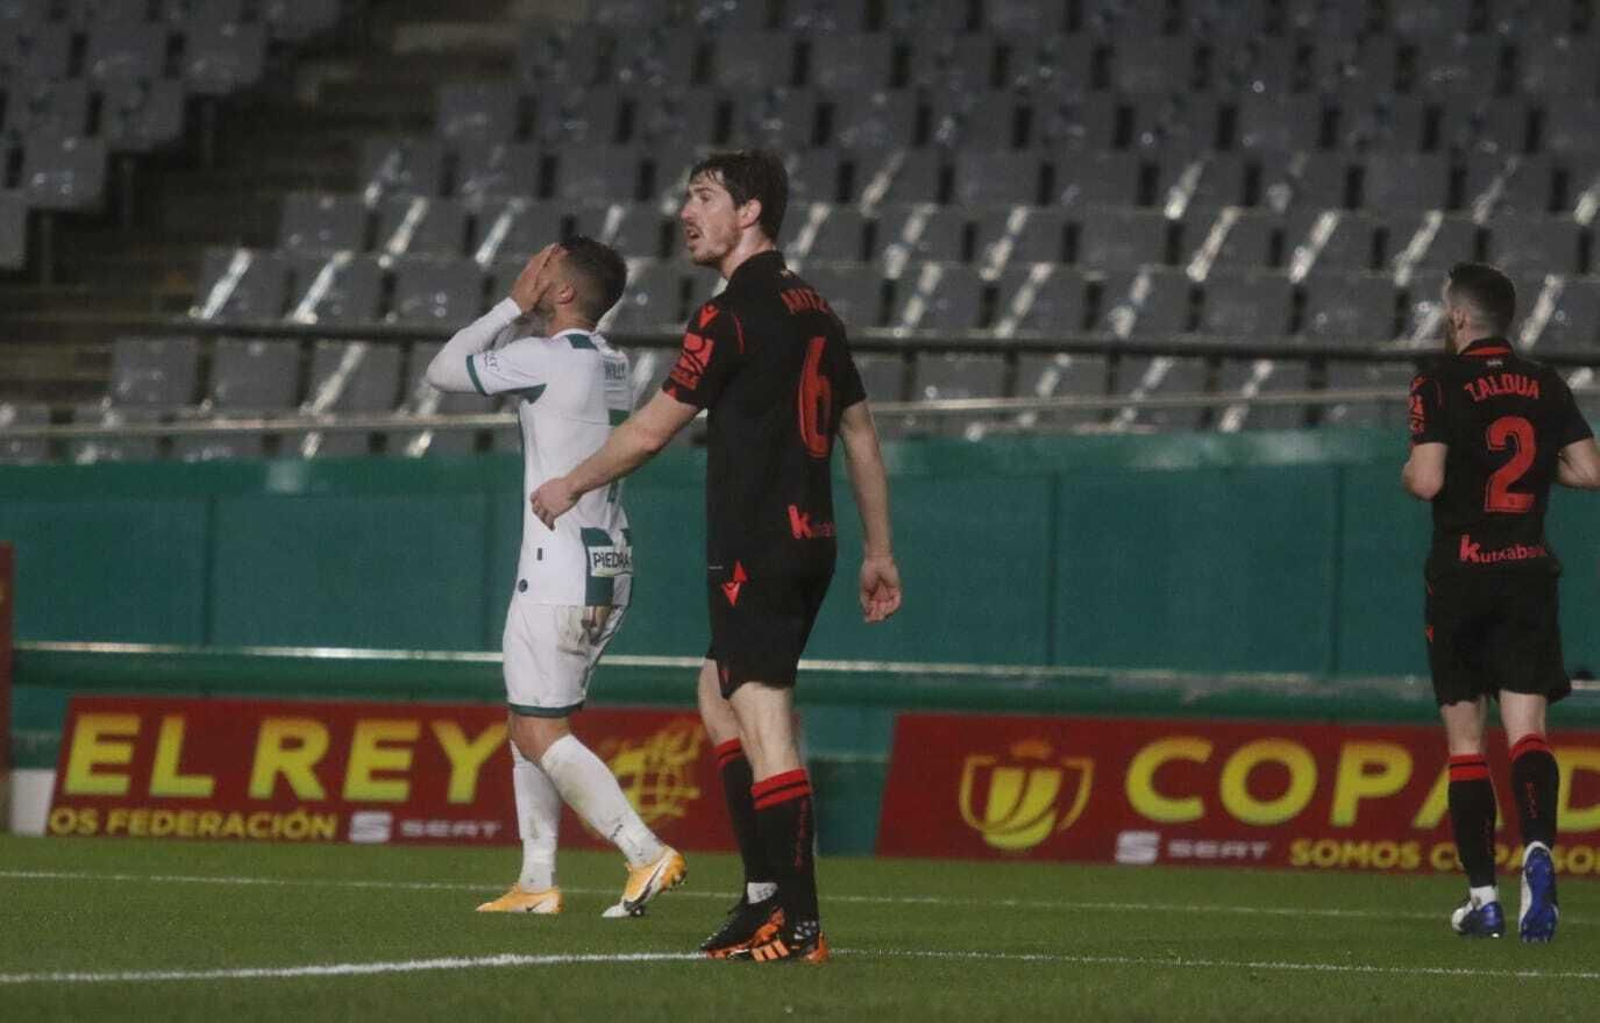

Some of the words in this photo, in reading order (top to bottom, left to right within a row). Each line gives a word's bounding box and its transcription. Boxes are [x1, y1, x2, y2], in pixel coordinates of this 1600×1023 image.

[799, 336, 833, 459] 6
[1463, 373, 1541, 402] ZALDUA
[1484, 415, 1536, 513] 2
[63, 713, 215, 798] EL
[248, 716, 509, 805] REY
[49, 807, 98, 835] OS
[105, 806, 337, 840] FEDERACIÓN
[401, 819, 502, 838] SEAT
[1168, 840, 1270, 859] SEAT
[1289, 838, 1421, 869] SOMOS
